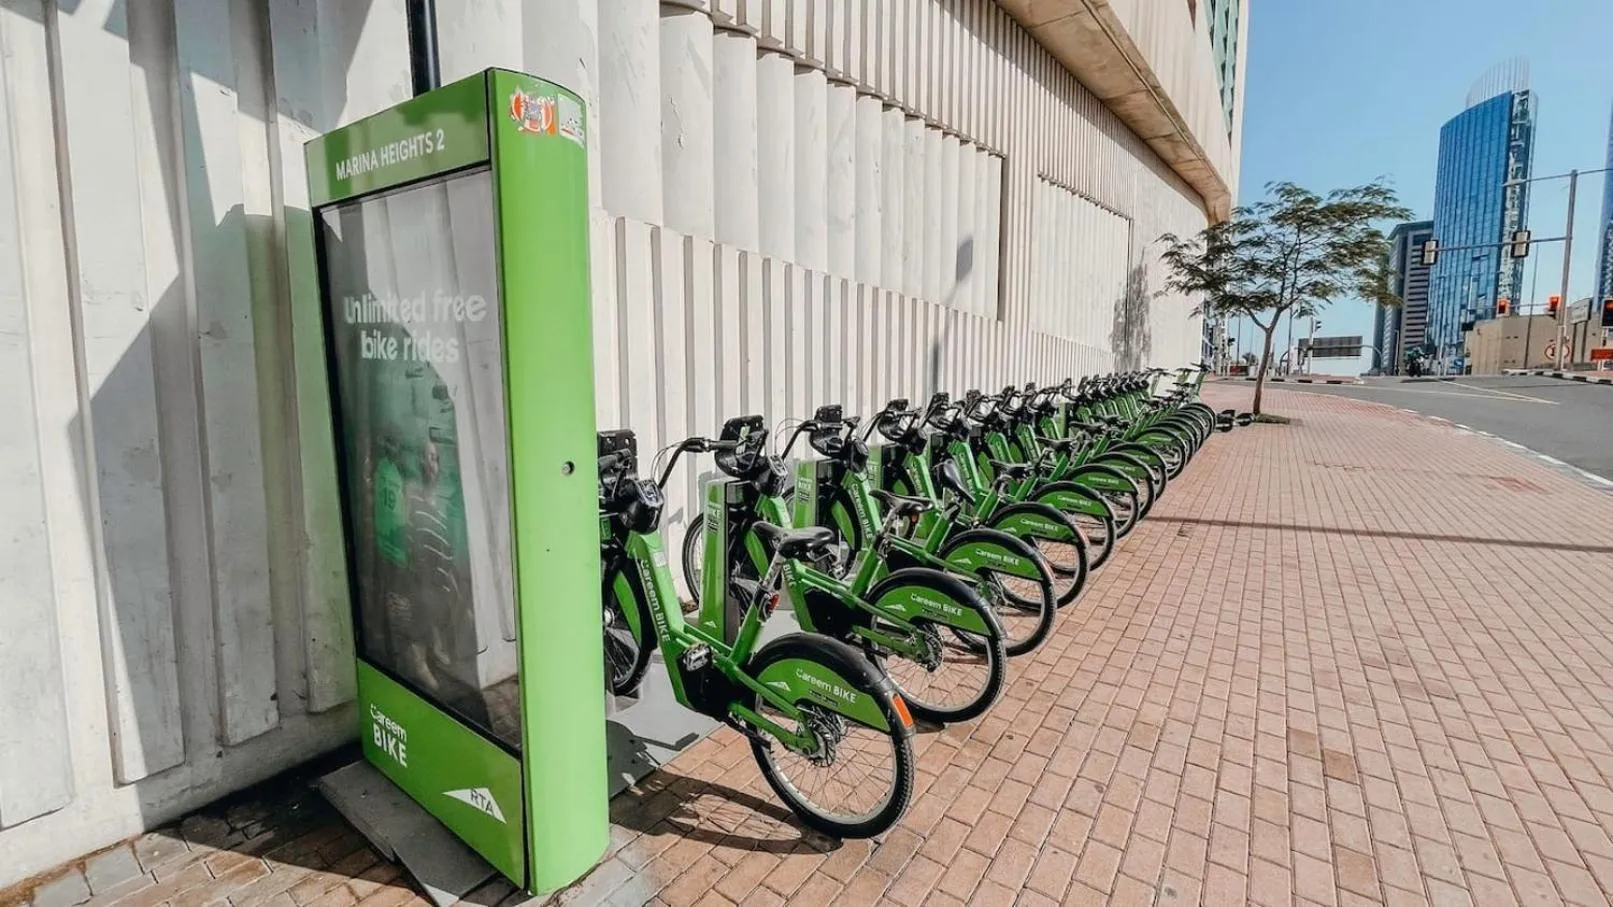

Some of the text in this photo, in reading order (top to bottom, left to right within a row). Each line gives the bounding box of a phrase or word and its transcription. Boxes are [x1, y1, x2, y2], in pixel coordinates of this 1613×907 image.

[336, 129, 445, 181] MARINA HEIGHTS 2
[344, 289, 487, 324] Unlimited free
[361, 329, 460, 362] bike rides
[640, 559, 671, 642] Careem BIKE
[911, 592, 941, 609] Careem
[943, 604, 963, 616] BIKE
[795, 668, 832, 692] Careem
[833, 685, 857, 703] BIKE
[370, 703, 407, 741] Careem
[373, 724, 408, 768] BIKE
[470, 788, 494, 816] RTA
